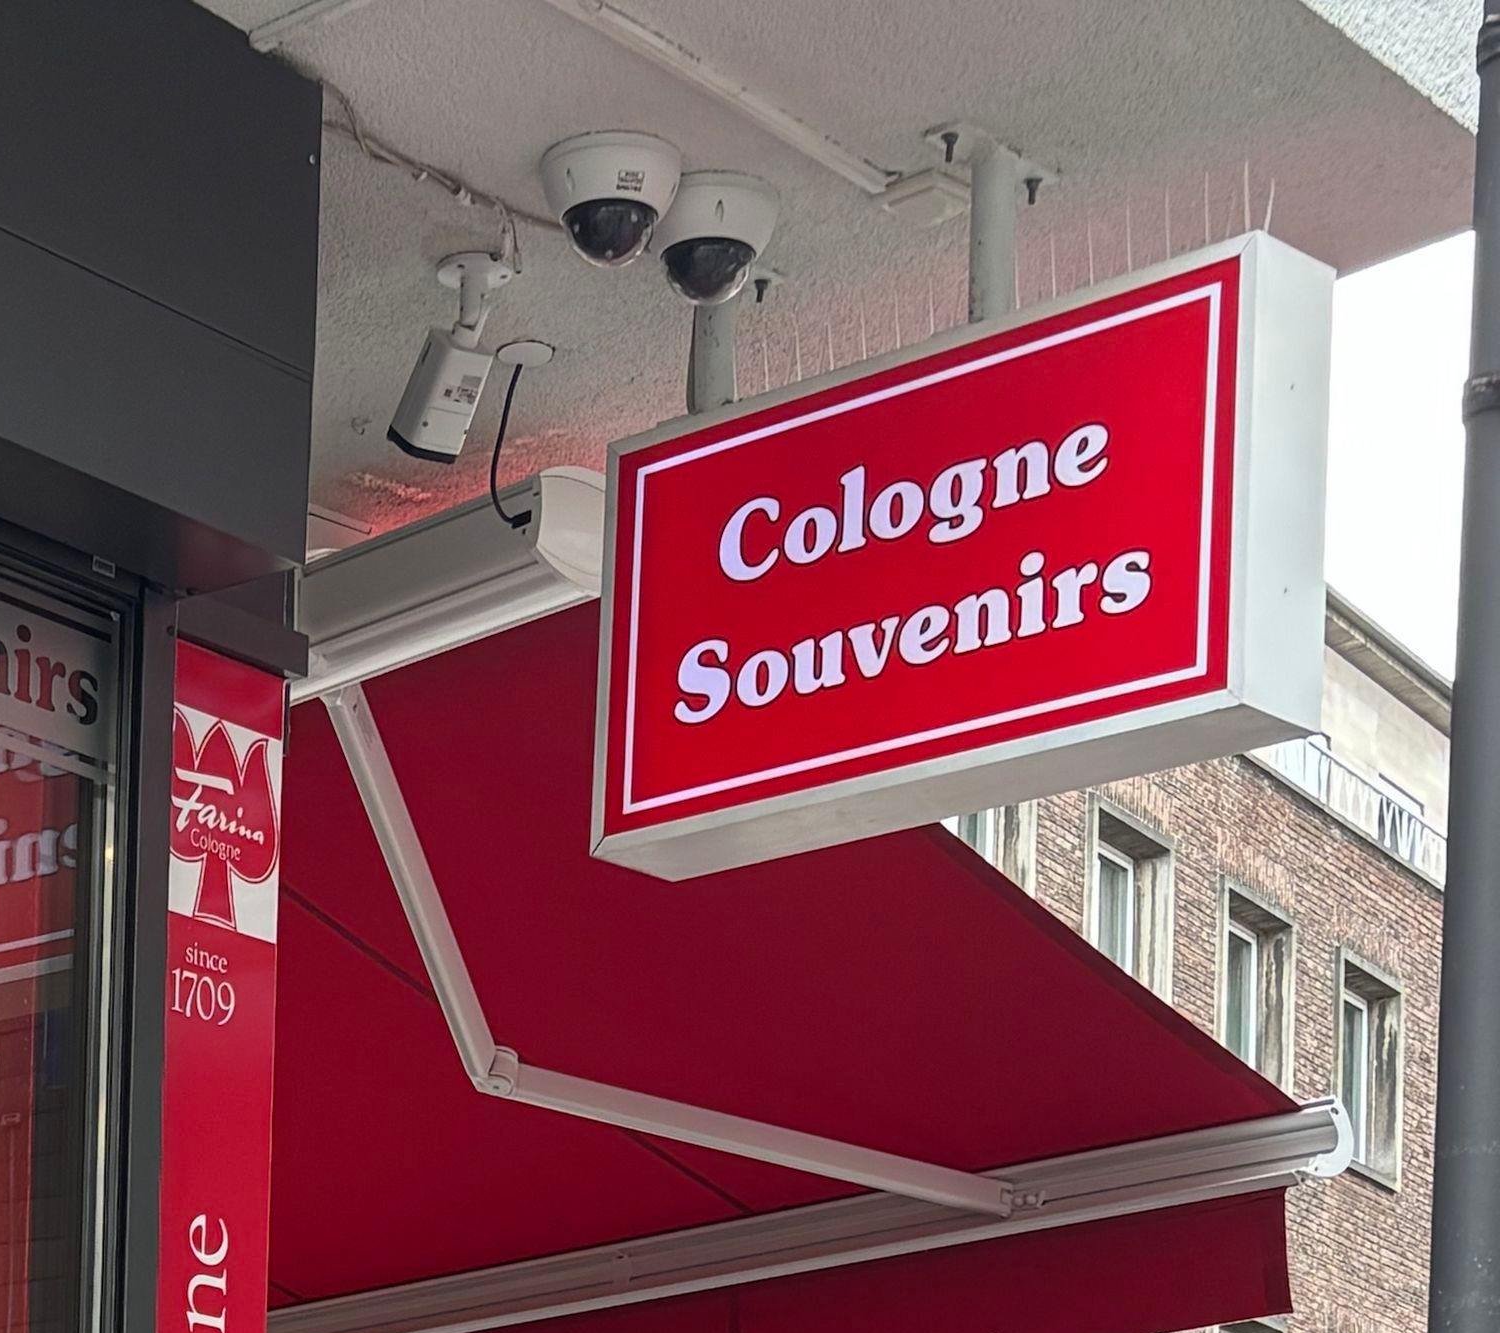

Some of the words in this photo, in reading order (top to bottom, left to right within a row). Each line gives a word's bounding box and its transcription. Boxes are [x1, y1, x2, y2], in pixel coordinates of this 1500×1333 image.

[717, 418, 1111, 584] Cologne
[672, 548, 1153, 726] Souvenirs
[171, 767, 264, 846] Farina
[190, 827, 241, 862] Cologne
[185, 942, 228, 974] since
[171, 967, 236, 1026] 1709
